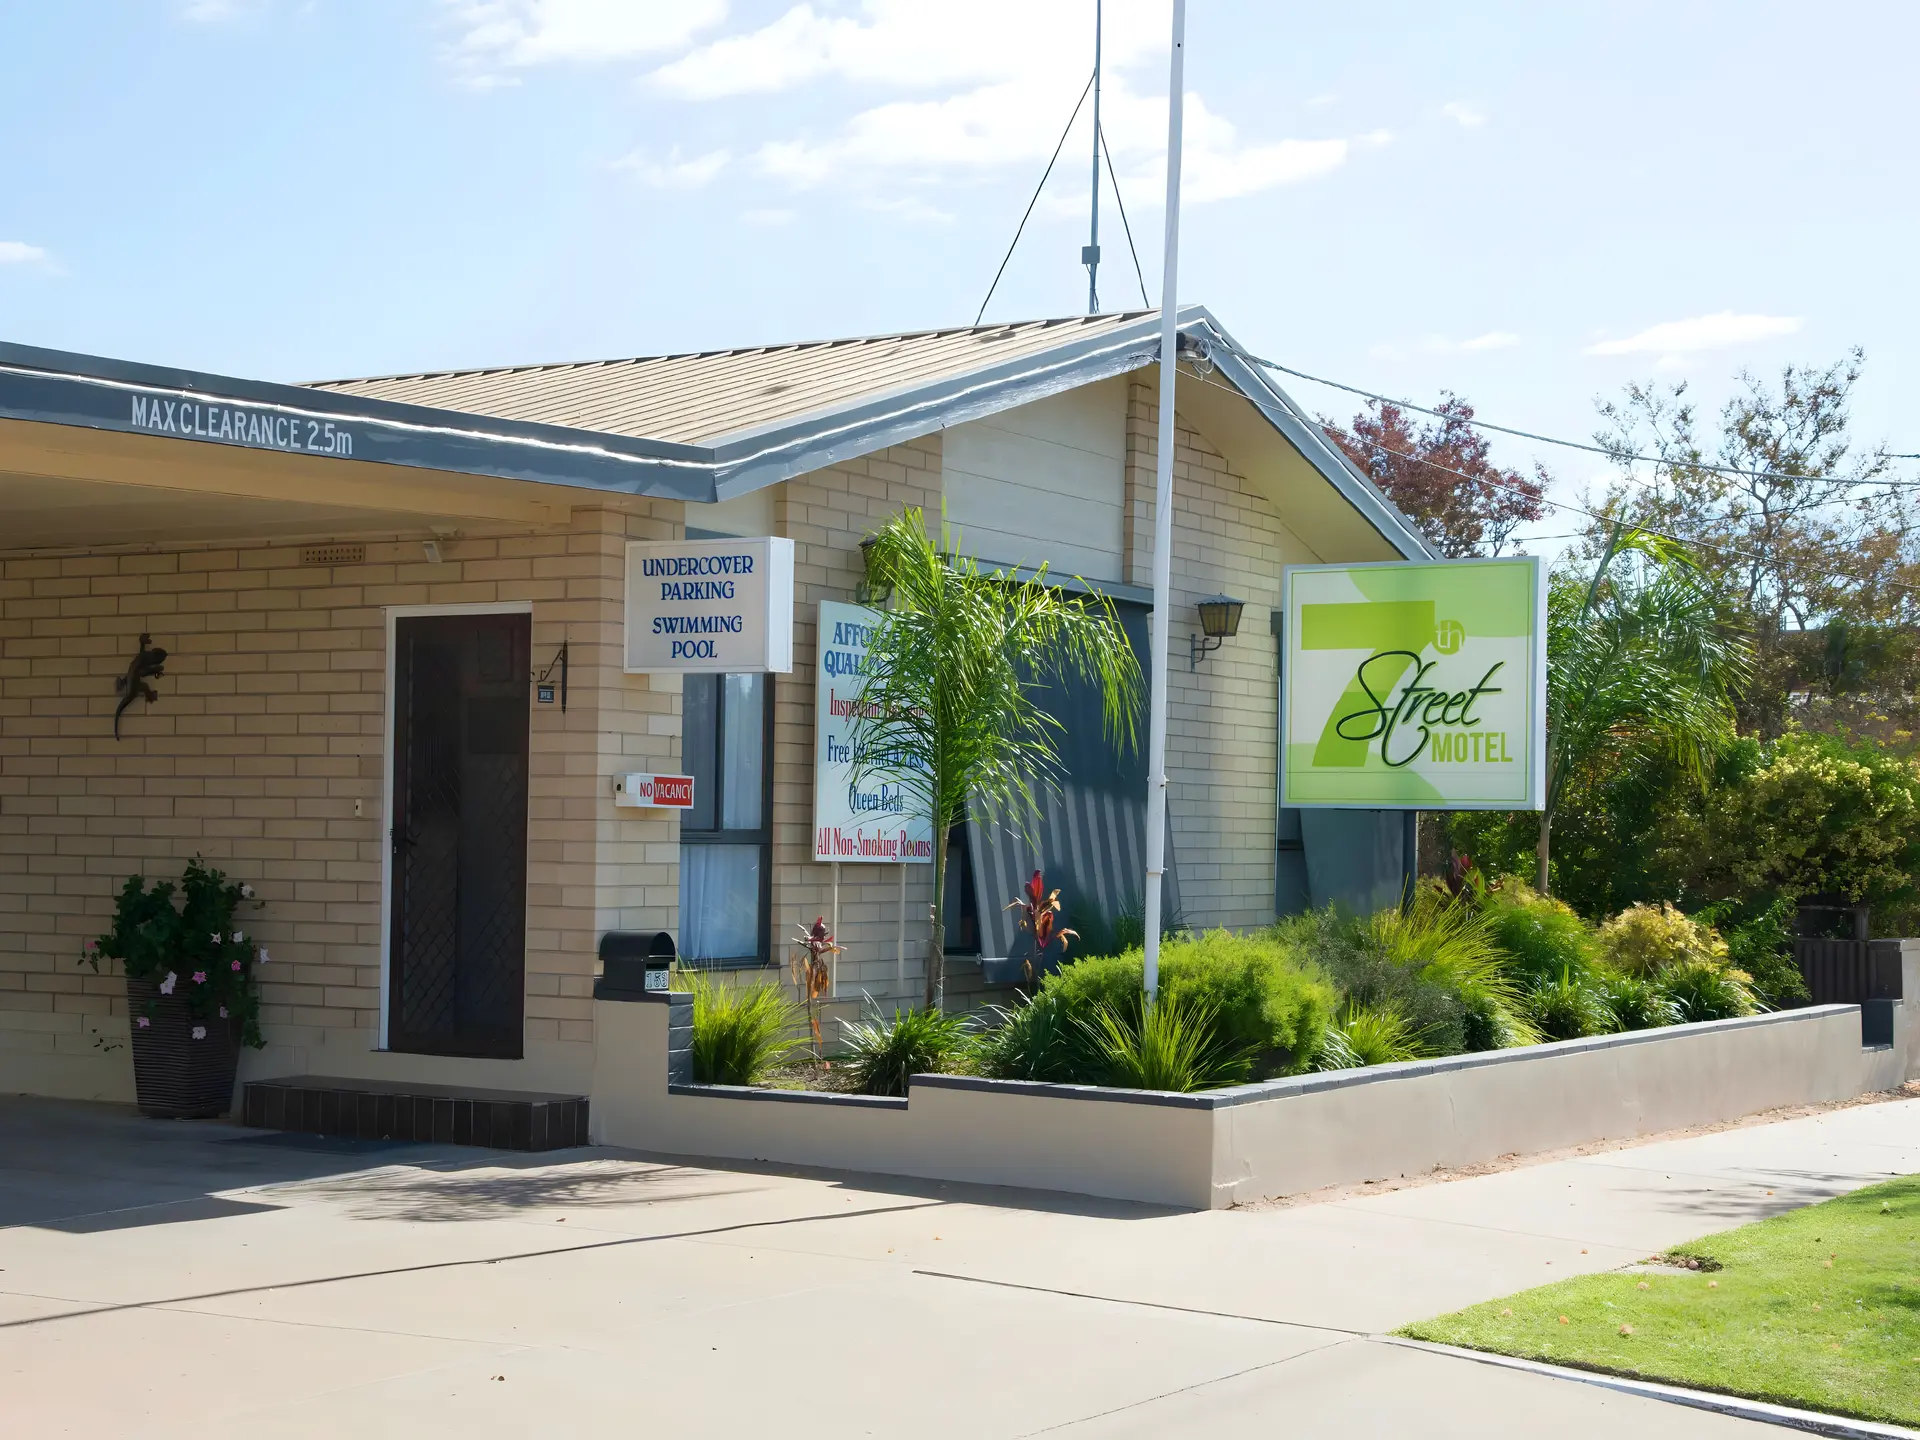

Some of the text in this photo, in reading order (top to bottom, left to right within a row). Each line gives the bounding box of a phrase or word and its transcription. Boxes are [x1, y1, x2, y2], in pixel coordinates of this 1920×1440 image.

[131, 395, 353, 455] MAX CLEARANCE 2.5m
[642, 555, 754, 577] UNDERCOVER
[661, 580, 735, 600] PARKING
[652, 615, 743, 634] SWIMMING
[671, 640, 718, 659] POOL
[1336, 650, 1506, 768] Street
[828, 735, 849, 764] Free
[1431, 732, 1513, 763] MOTEL
[640, 782, 692, 800] NO VACANCY
[848, 782, 904, 814] Queen Beds
[817, 827, 931, 860] All Non-Smoking Rooms
